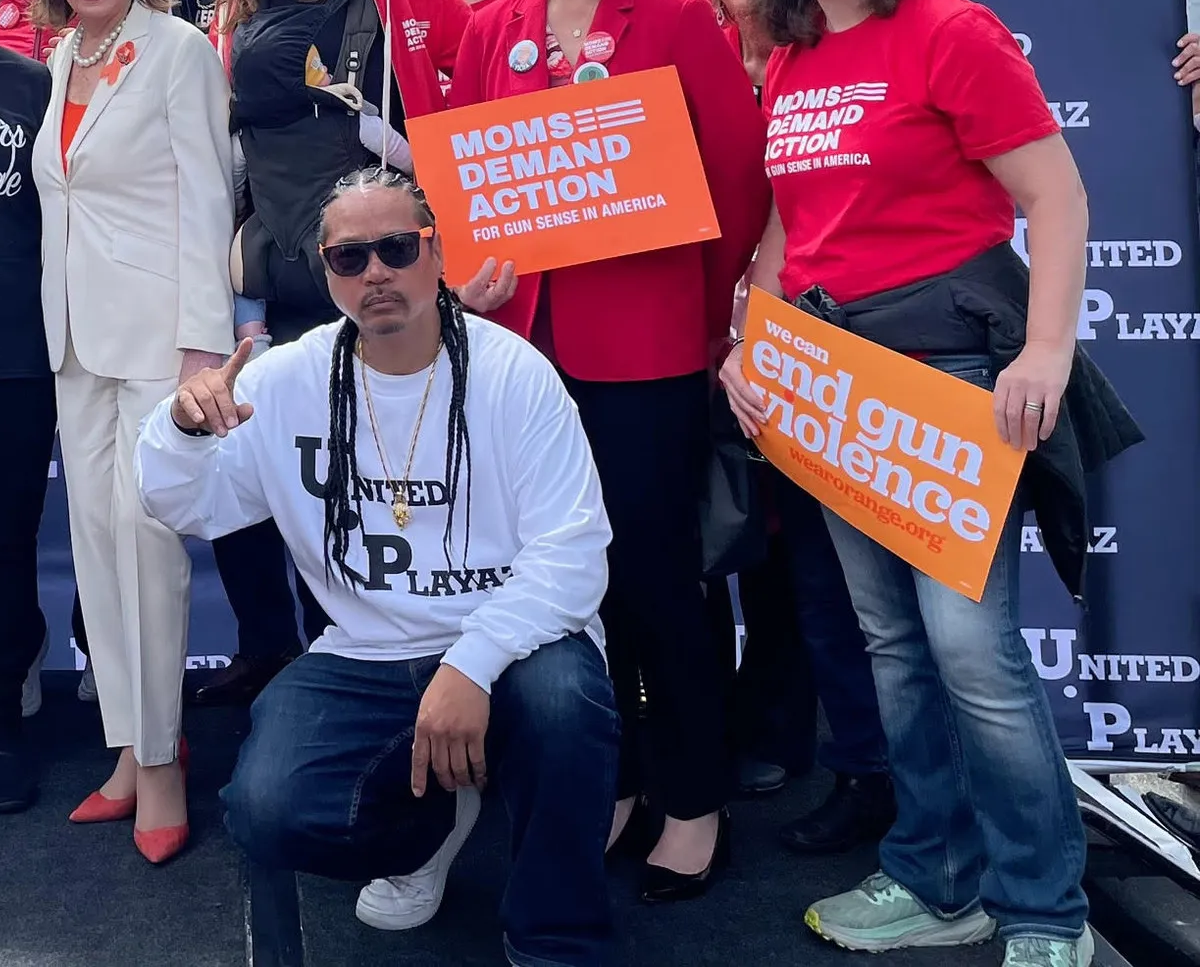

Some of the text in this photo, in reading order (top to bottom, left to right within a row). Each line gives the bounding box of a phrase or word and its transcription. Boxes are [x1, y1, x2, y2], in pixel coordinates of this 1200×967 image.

[766, 104, 864, 138] DEMAND
[772, 85, 842, 116] MOMS
[450, 112, 575, 160] MOMS
[458, 134, 631, 190] DEMAND
[787, 158, 812, 174] SENSE
[813, 158, 822, 169] IN
[824, 153, 871, 167] AMERICA
[468, 168, 618, 222] ACTION
[473, 194, 667, 242] FOR GUN SENSE IN AMERICA
[765, 318, 829, 365] we can
[752, 340, 984, 486] end gun
[750, 381, 991, 543] violence
[787, 446, 946, 554] wearorange.org
[1020, 628, 1200, 682] UNITED
